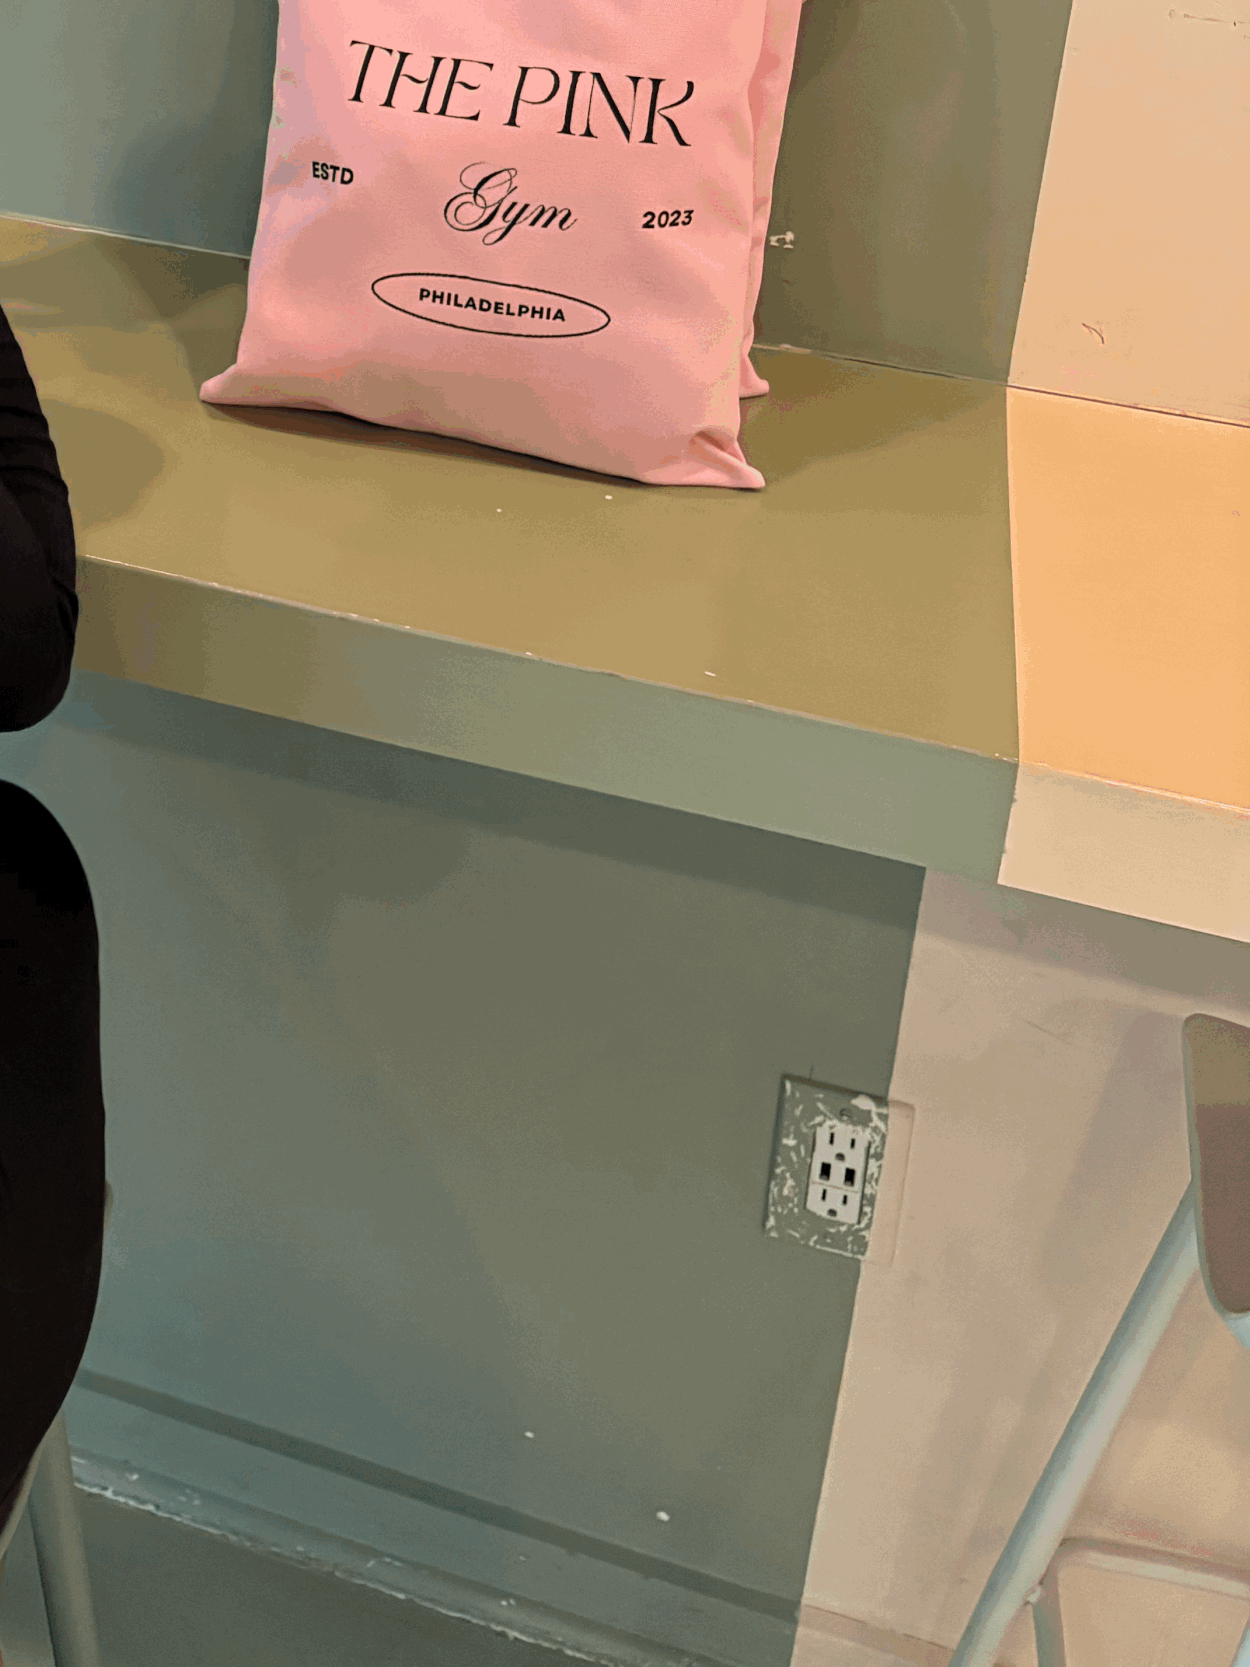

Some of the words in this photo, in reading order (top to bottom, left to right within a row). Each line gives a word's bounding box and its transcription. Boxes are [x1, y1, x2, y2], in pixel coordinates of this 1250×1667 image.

[347, 39, 495, 122] THE
[502, 65, 696, 148] PINK
[311, 160, 355, 186] ESTD
[443, 160, 578, 246] Gym
[641, 209, 695, 230] 2023
[418, 287, 567, 323] PHILADELPHIA
